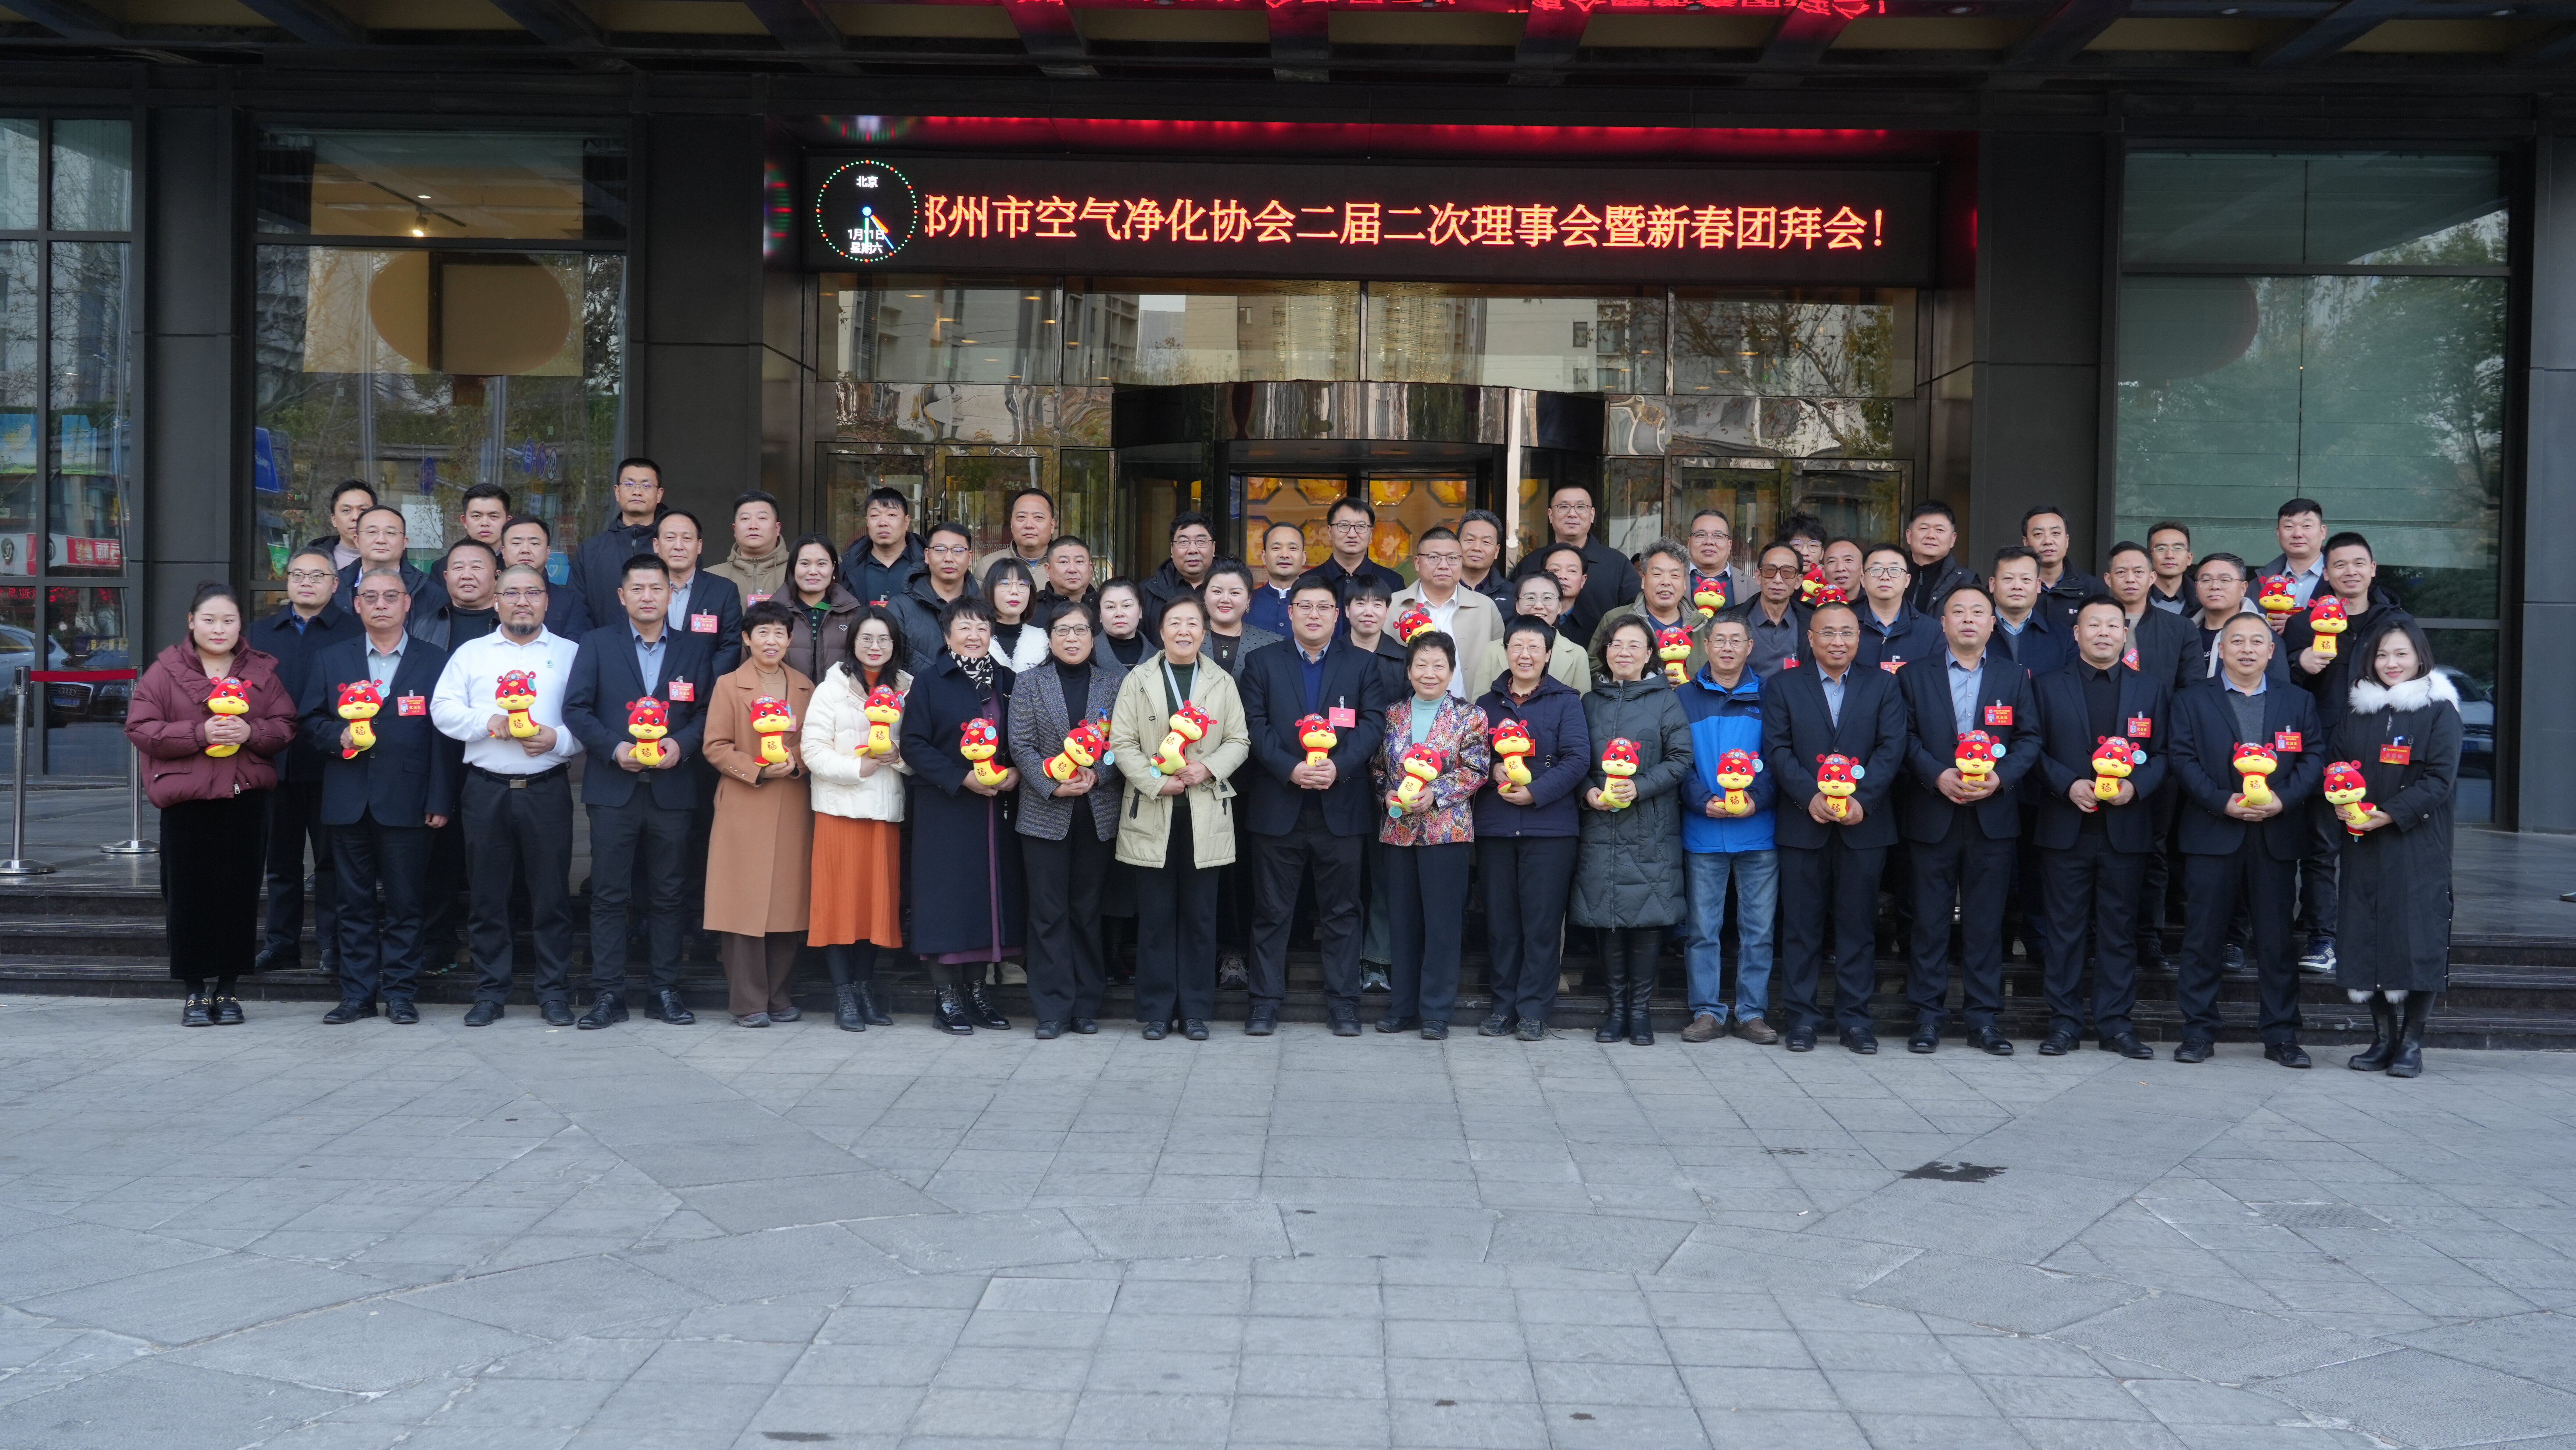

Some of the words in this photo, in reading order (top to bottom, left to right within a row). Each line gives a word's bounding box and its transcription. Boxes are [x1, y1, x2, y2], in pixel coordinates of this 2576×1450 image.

[856, 175, 879, 188] 北京
[848, 229, 884, 240] 1月1日
[851, 242, 883, 254] 星期六
